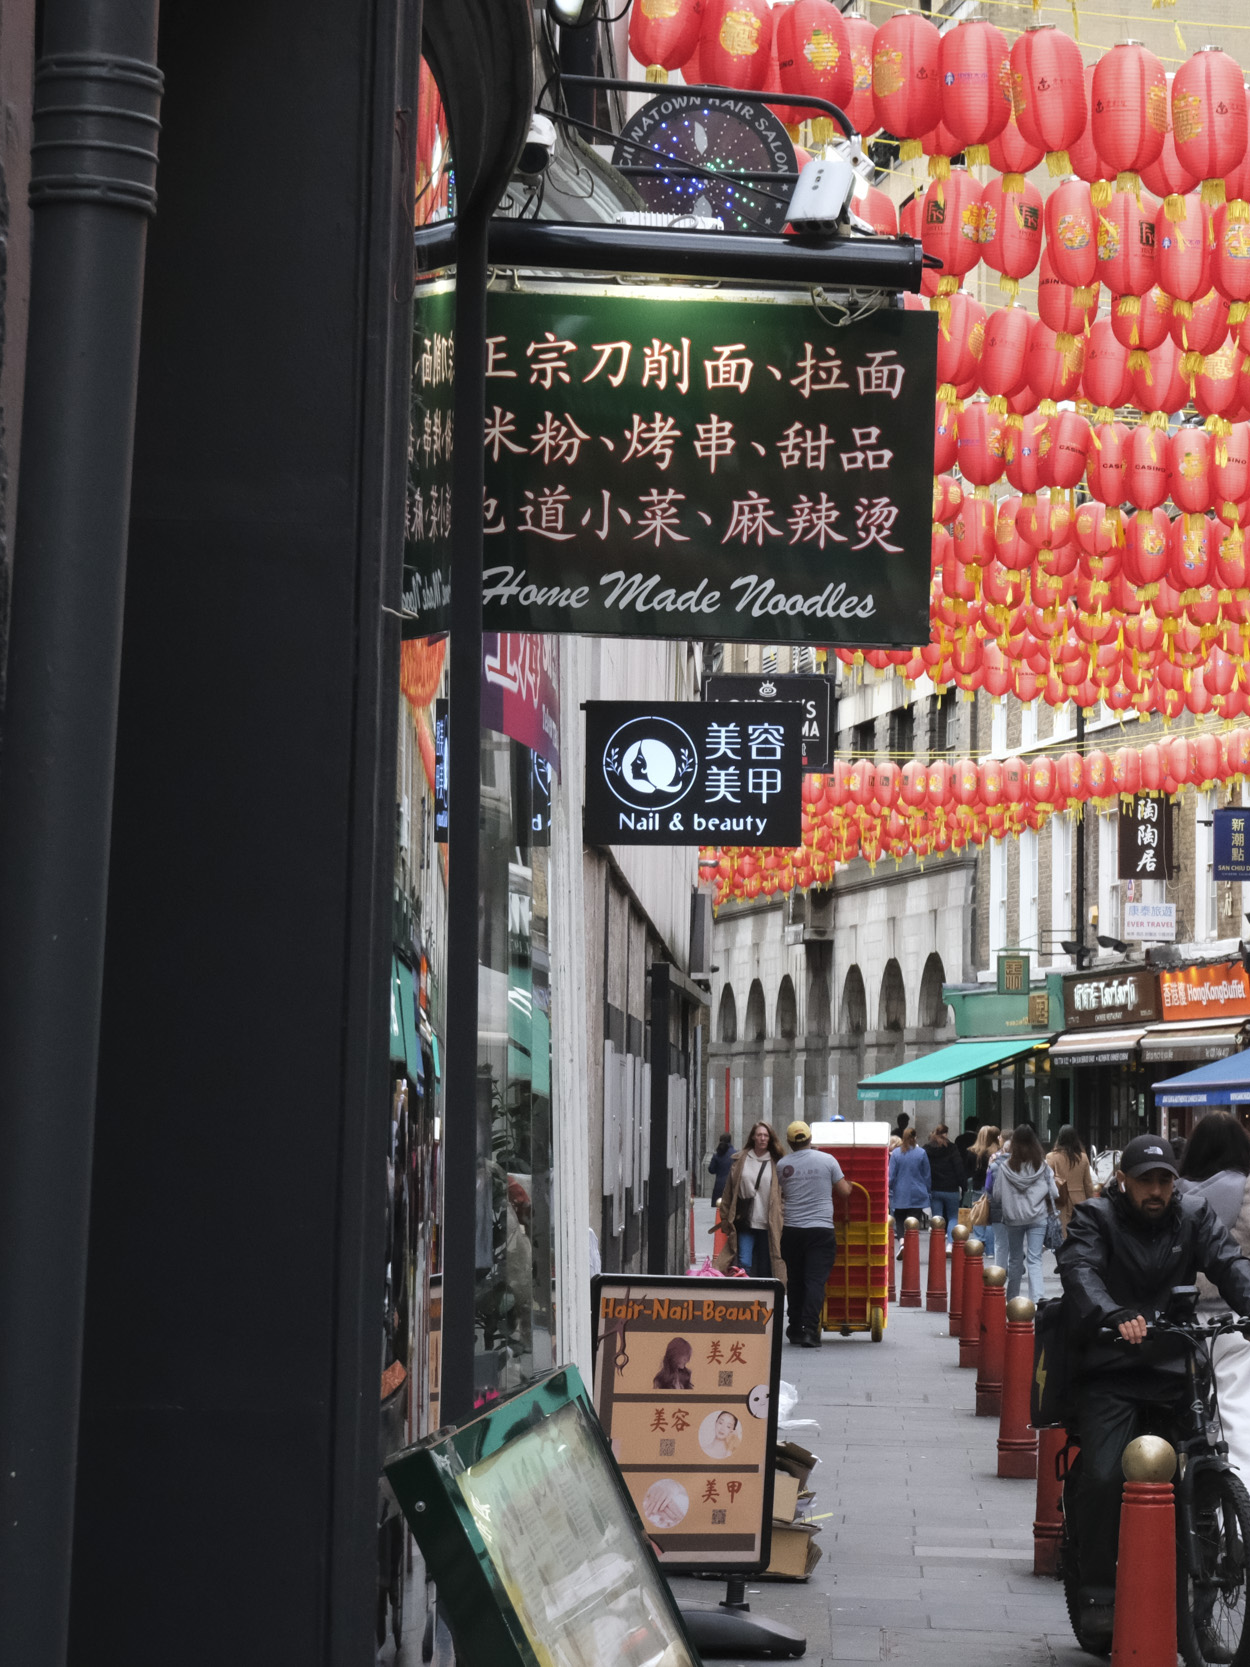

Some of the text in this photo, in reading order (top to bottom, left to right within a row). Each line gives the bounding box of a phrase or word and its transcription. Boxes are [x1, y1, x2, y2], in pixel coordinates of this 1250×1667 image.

[619, 96, 790, 174] CHNATOWN HAIR SALON
[486, 332, 905, 400] 正宗刀削面、拉面
[484, 405, 894, 474] 米粉、烤串、甜品
[1134, 464, 1166, 473] CASINO
[1227, 456, 1247, 465] SINO
[483, 565, 877, 619] Home Made Noodles
[705, 722, 785, 760] 美容
[704, 765, 782, 804] 美甲
[619, 812, 768, 836] Nail & beauty
[1136, 798, 1158, 873] 陶陶居
[1231, 817, 1245, 862] 新潮點
[1217, 864, 1230, 872] SAN
[1231, 864, 1246, 872] CHIU
[706, 1340, 747, 1366] 美发
[650, 1408, 690, 1433] 美容
[702, 1478, 743, 1504] 美甲
